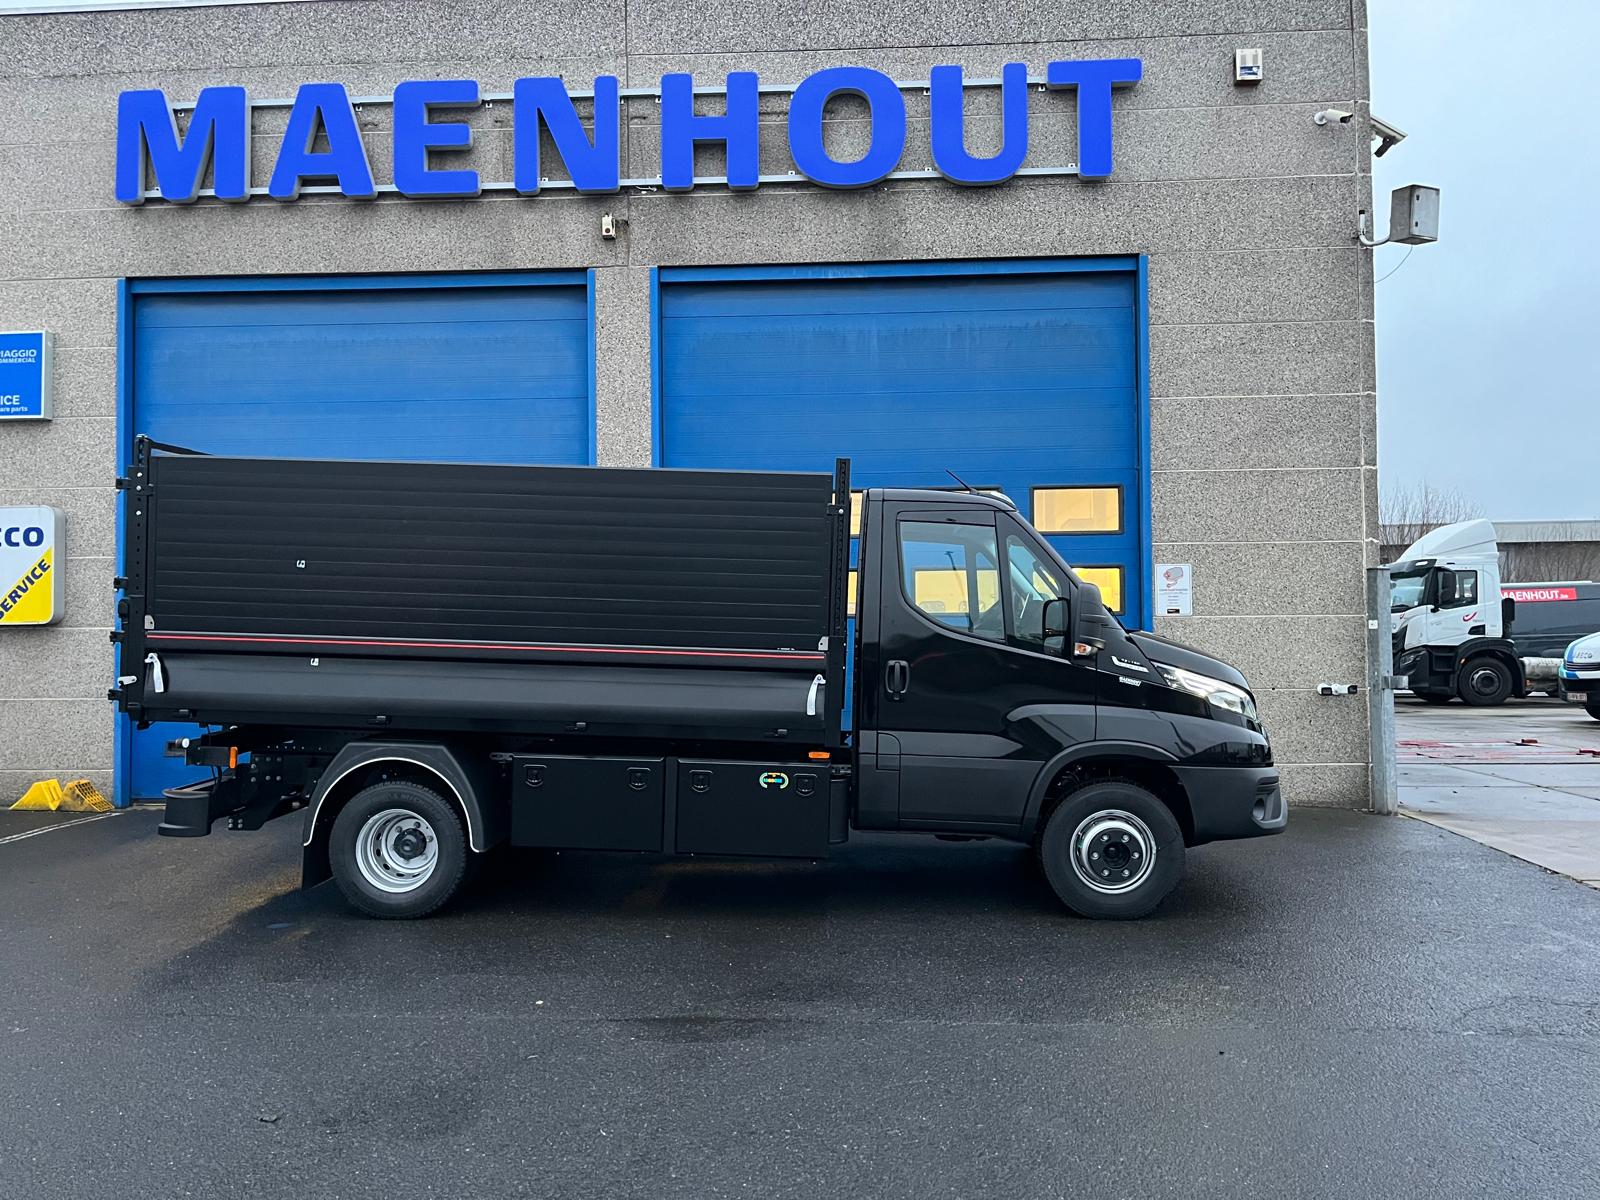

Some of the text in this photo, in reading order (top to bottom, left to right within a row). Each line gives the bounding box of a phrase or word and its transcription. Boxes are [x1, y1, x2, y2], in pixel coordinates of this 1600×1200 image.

[115, 58, 1142, 206] MAENHOUT
[0, 394, 20, 405] ICE
[10, 406, 28, 414] parts
[0, 527, 44, 547] CO
